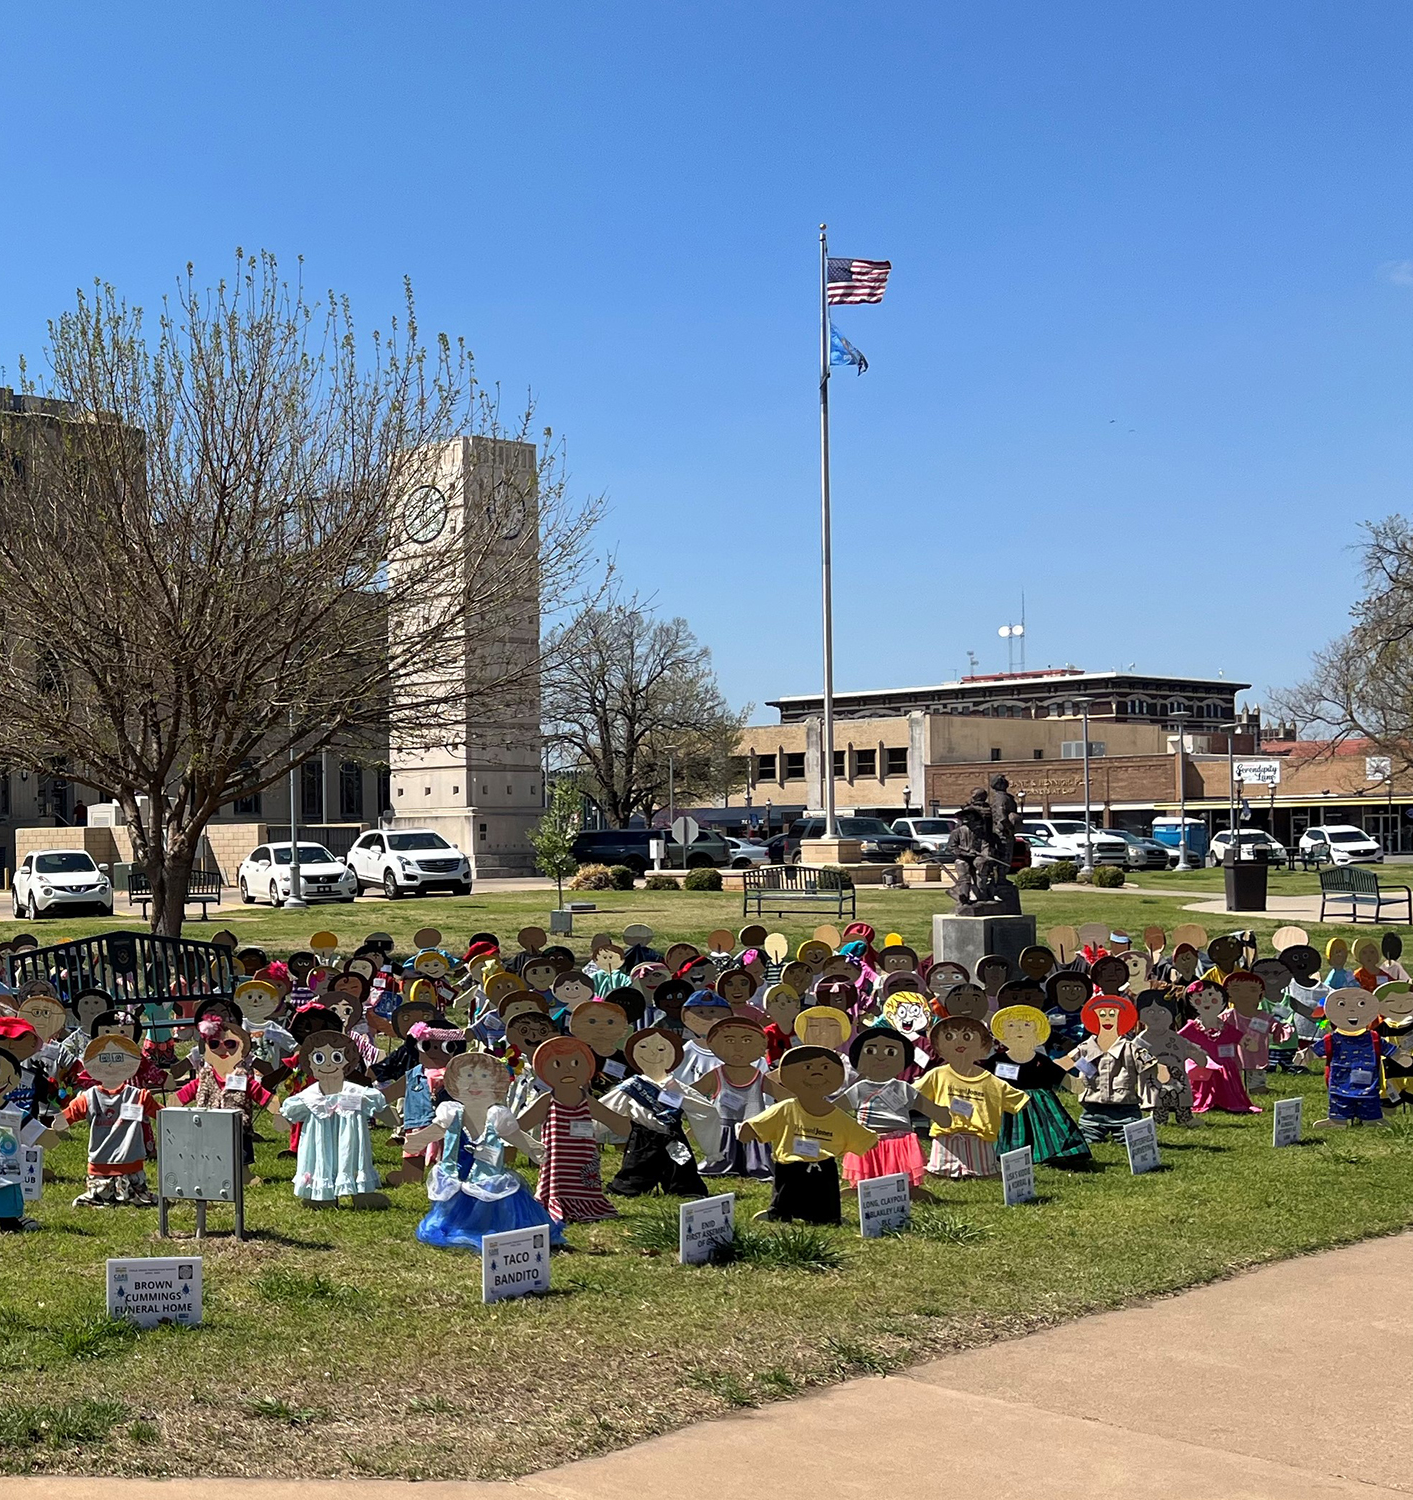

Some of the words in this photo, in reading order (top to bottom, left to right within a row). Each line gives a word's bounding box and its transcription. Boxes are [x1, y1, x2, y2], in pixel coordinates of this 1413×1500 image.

[1236, 764, 1277, 775] Serendipity
[967, 1088, 984, 1097] Jones
[815, 1129, 833, 1137] Jones
[881, 1194, 906, 1205] CLAYPOLE
[701, 1220, 715, 1229] ENID
[686, 1231, 701, 1242] FIRST
[503, 1252, 530, 1266] TACO
[495, 1268, 539, 1286] BANDITO
[134, 1281, 172, 1290] BROWN
[125, 1292, 182, 1302] CUMMINGS
[115, 1304, 159, 1314] FUNERAL
[162, 1303, 192, 1312] HOME
